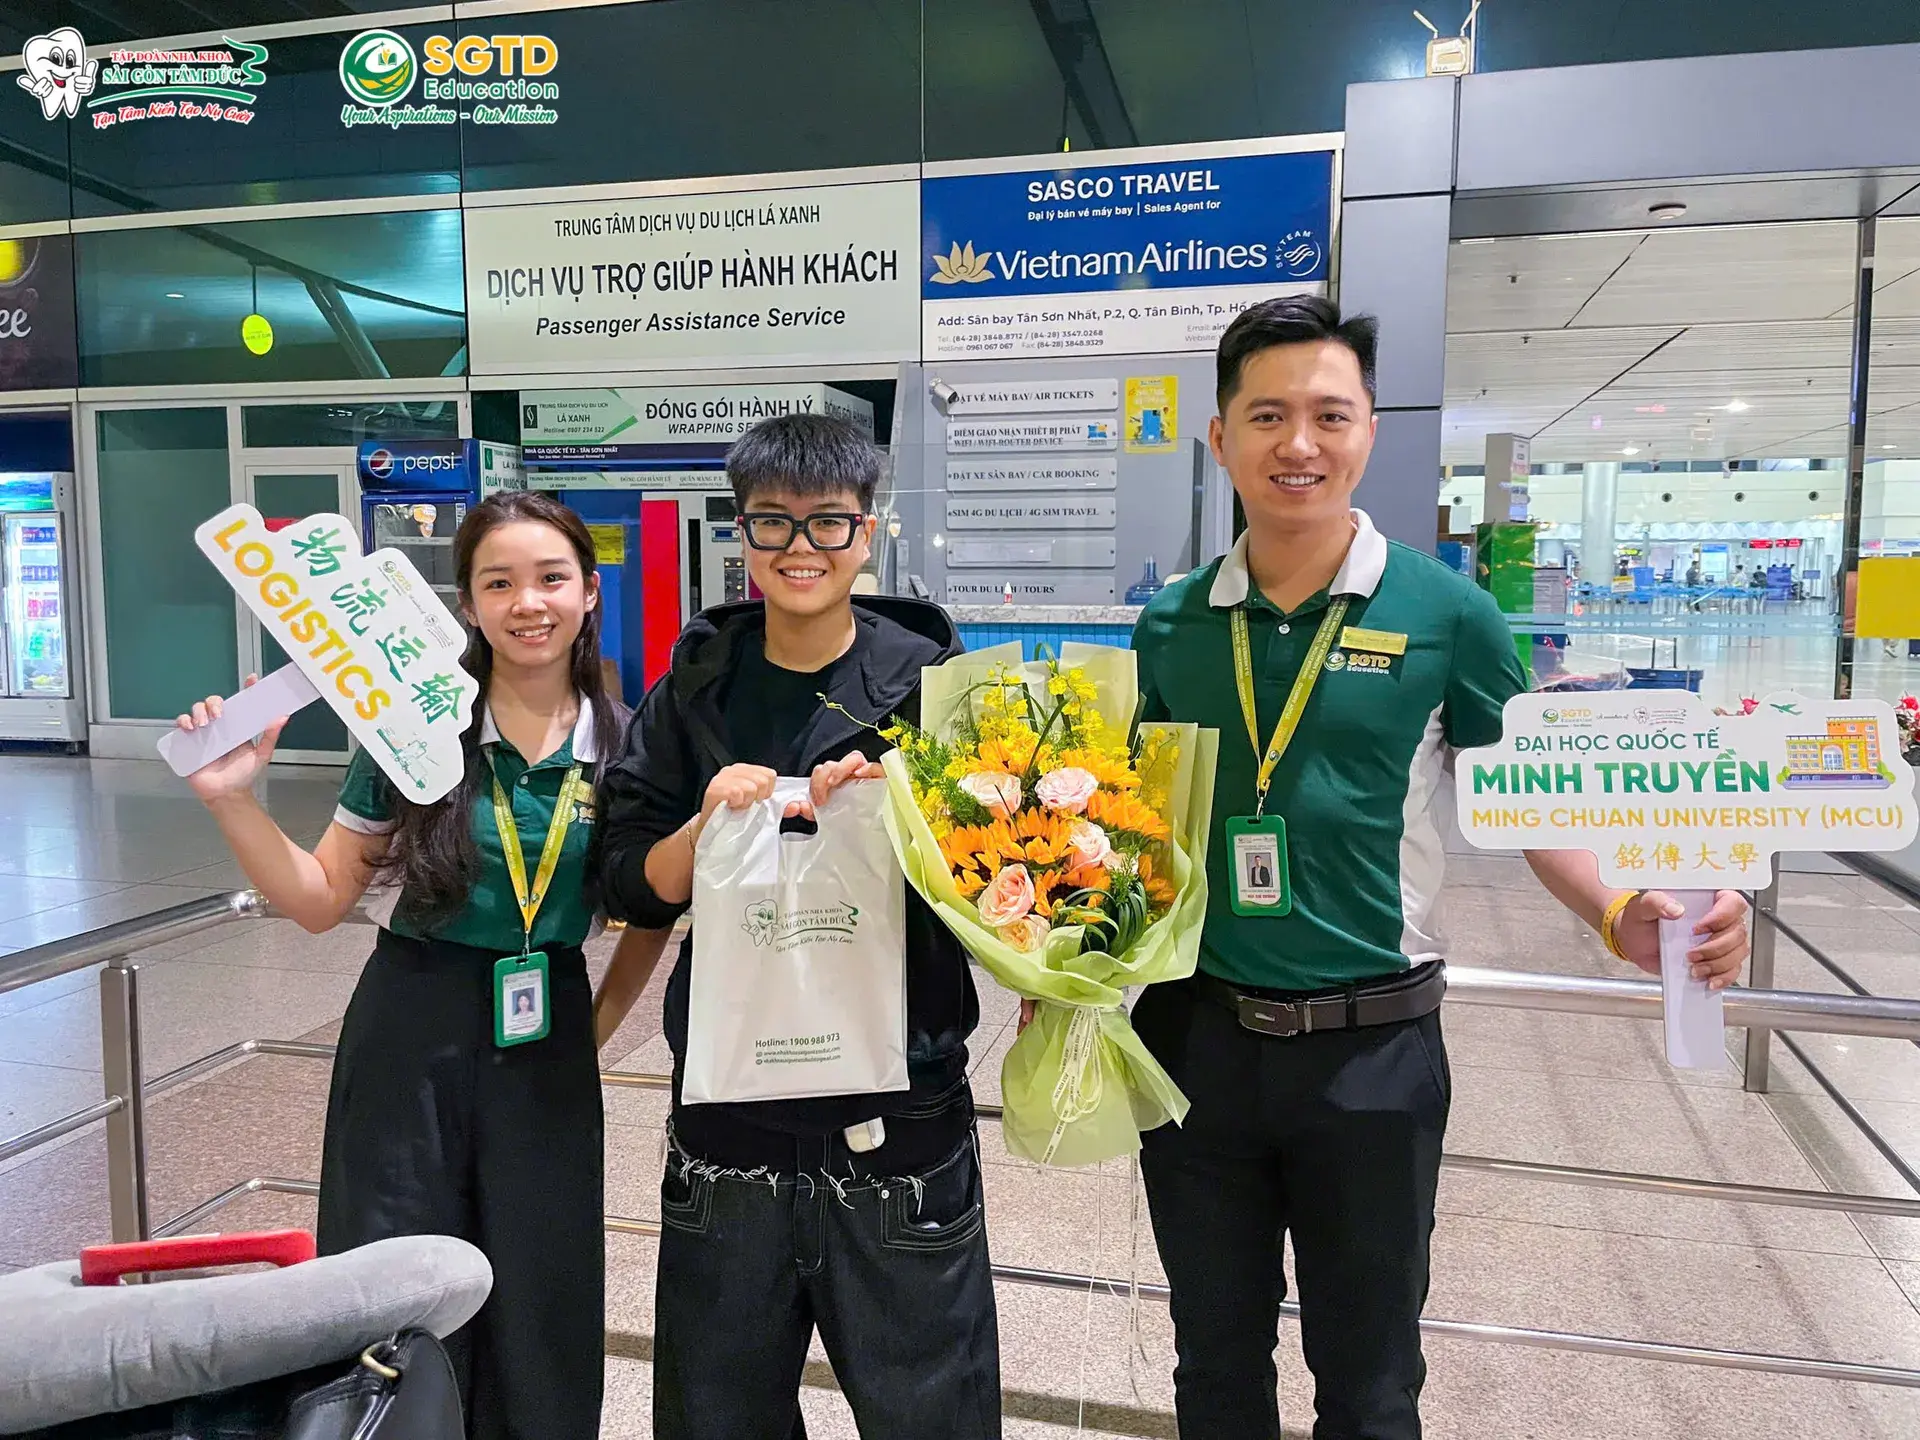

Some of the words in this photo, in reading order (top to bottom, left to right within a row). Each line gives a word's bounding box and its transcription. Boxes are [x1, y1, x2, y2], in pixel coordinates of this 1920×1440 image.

[1027, 176, 1114, 203] SASCO
[1120, 169, 1220, 196] TRAVEL
[555, 218, 602, 238] TRUNG
[605, 212, 636, 235] TÂM
[639, 215, 672, 237] DỊCH
[675, 213, 696, 235] VỤ
[699, 211, 721, 230] DU
[724, 209, 754, 233] LỊCH
[758, 202, 775, 227] LÁ
[779, 204, 821, 225] XANH
[1028, 211, 1044, 222] Đại
[1046, 210, 1055, 222] lý
[1057, 207, 1076, 220] bán
[1077, 207, 1089, 219] vé
[1091, 206, 1113, 220] máy
[1115, 205, 1134, 218] bay
[1144, 202, 1172, 214] Sales
[1174, 201, 1203, 214] Agent
[1206, 200, 1221, 211] for
[994, 248, 1134, 281] Vietnam
[1137, 238, 1268, 274] Airlines
[1275, 230, 1312, 269] SKYTEAM
[488, 266, 544, 306] DỊCH
[552, 265, 585, 303] VỤ
[592, 262, 646, 300] TRỢ
[653, 252, 714, 292] GIÚP
[721, 248, 794, 289] HÀNH
[803, 243, 898, 285] KHÁCH
[536, 312, 642, 338] Passenger
[645, 307, 761, 333] Assistance
[766, 305, 846, 328] Service
[937, 316, 965, 326] Add:
[967, 314, 989, 325] Sân
[992, 314, 1014, 326] bay
[1017, 313, 1038, 323] Tân
[1041, 311, 1064, 322] Sơn
[1103, 309, 1125, 321] P.2,
[1128, 308, 1141, 319] Q.
[1144, 306, 1167, 317] Tân
[1171, 304, 1203, 317] Bình,
[1207, 304, 1226, 316] Tp.
[952, 334, 981, 343] (84-28)
[966, 343, 983, 351] 0961
[984, 343, 999, 351] 067
[645, 398, 697, 419] ĐÓNG
[702, 397, 733, 418] GÓI
[740, 395, 790, 417] HÀNH
[988, 392, 1010, 401] MÁY
[1035, 391, 1051, 400] AIR
[1053, 390, 1095, 400] TICKETS
[557, 413, 567, 423] LÁ
[668, 423, 733, 434] WRAPPING
[404, 451, 456, 474] pepsi
[973, 471, 986, 480] XE
[1008, 471, 1026, 479] BAY
[1032, 470, 1053, 479] CAR
[1054, 469, 1100, 479] BOOKING
[952, 509, 970, 517] SIM
[971, 509, 983, 517] 4G
[984, 509, 998, 517] DU
[999, 509, 1023, 519] LỊCH
[1029, 509, 1041, 517] 4G
[1043, 508, 1060, 517] SIM
[1062, 508, 1100, 516] TRAVEL
[980, 585, 993, 593] DU
[994, 585, 1017, 594] LỊH
[1024, 585, 1055, 593] TOURS
[212, 518, 392, 721] LOGISTICS
[1514, 733, 1553, 757] ĐẠI
[1559, 733, 1609, 757] HỌC
[1616, 726, 1687, 751] QUỐC
[1693, 726, 1721, 750] TẾ
[1472, 762, 1583, 795] MINH
[1595, 748, 1771, 794] TRUYỀN
[1471, 807, 1541, 828] MING
[1549, 807, 1646, 828] CHUAN
[1653, 806, 1811, 828] UNIVERSITY
[1821, 804, 1904, 830] (MCU)
[1615, 840, 1760, 873] 銘傳大學
[756, 1038, 788, 1048] Hotline:
[790, 1037, 809, 1046] 1900
[811, 1036, 825, 1045] 988
[826, 1032, 840, 1042] 973
